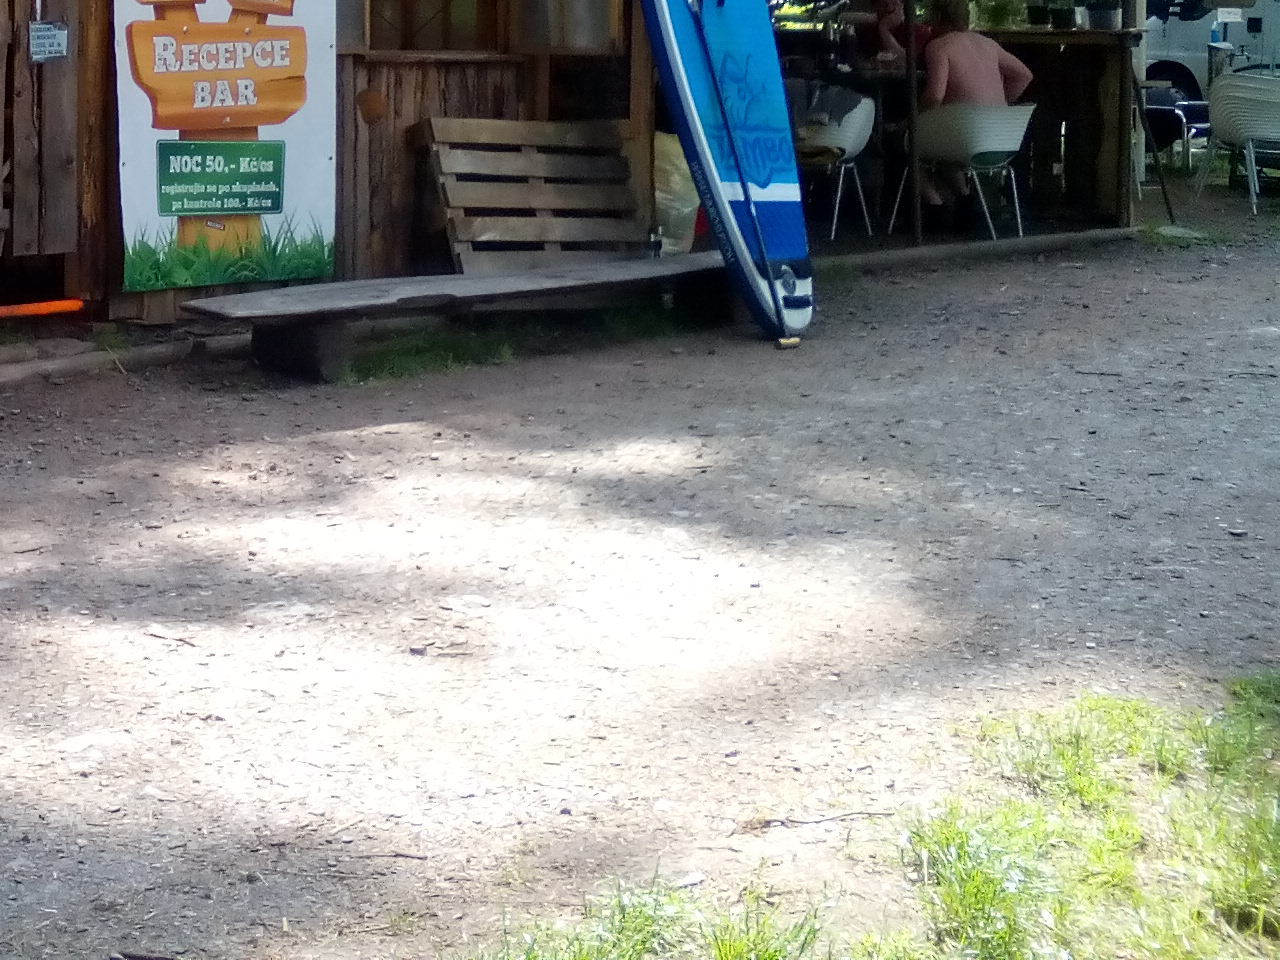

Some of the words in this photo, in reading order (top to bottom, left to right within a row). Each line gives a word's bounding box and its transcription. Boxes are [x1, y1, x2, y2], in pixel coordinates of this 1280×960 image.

[153, 36, 291, 73] RECEPCE
[193, 79, 258, 109] BAR
[169, 155, 202, 173] NOC
[205, 155, 236, 174] 50,-
[206, 185, 217, 193] se
[218, 184, 230, 195] po
